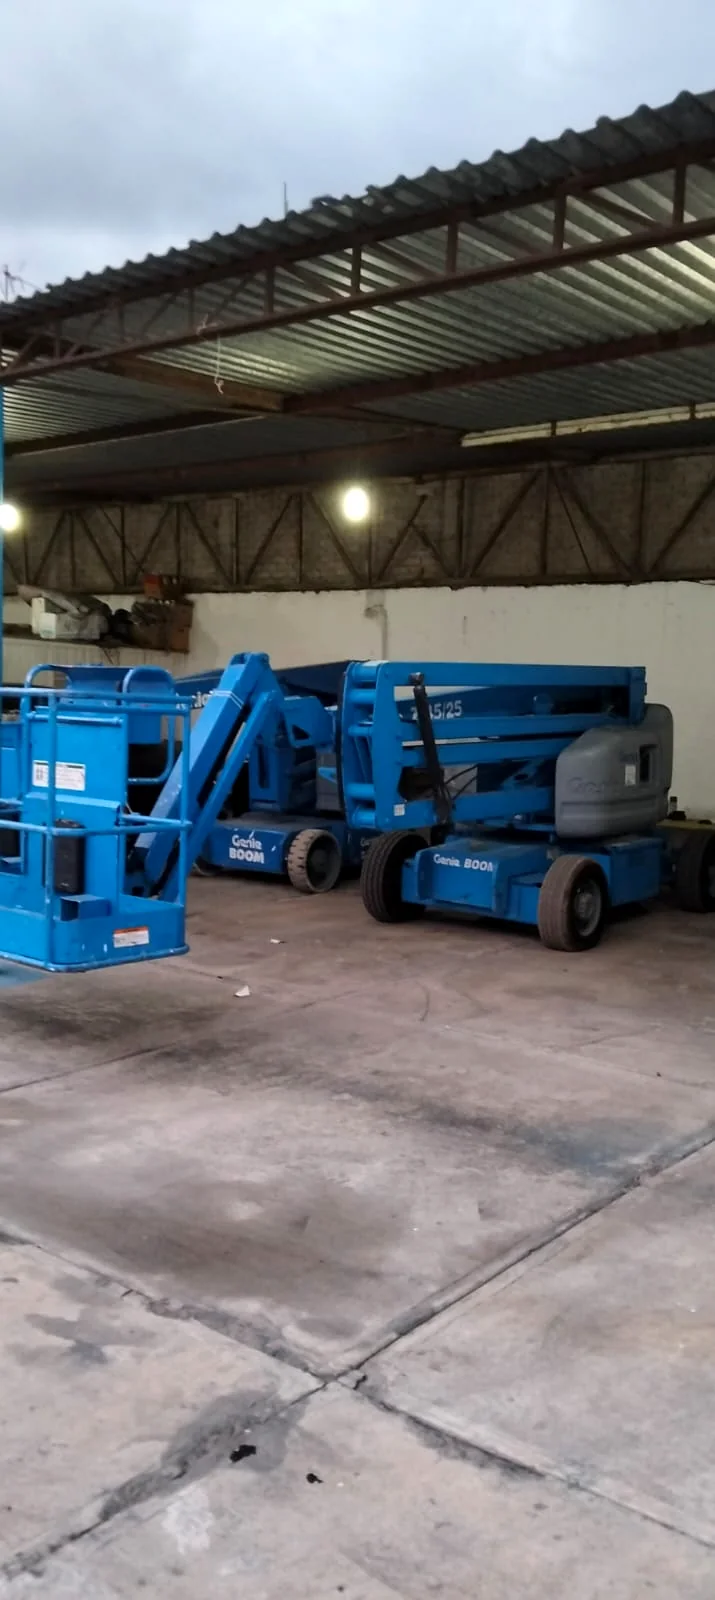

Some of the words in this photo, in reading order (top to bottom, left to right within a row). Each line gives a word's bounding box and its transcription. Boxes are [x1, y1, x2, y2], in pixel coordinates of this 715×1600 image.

[231, 834, 263, 850] Genie
[229, 847, 265, 864] BOOM
[433, 853, 461, 868] Genie
